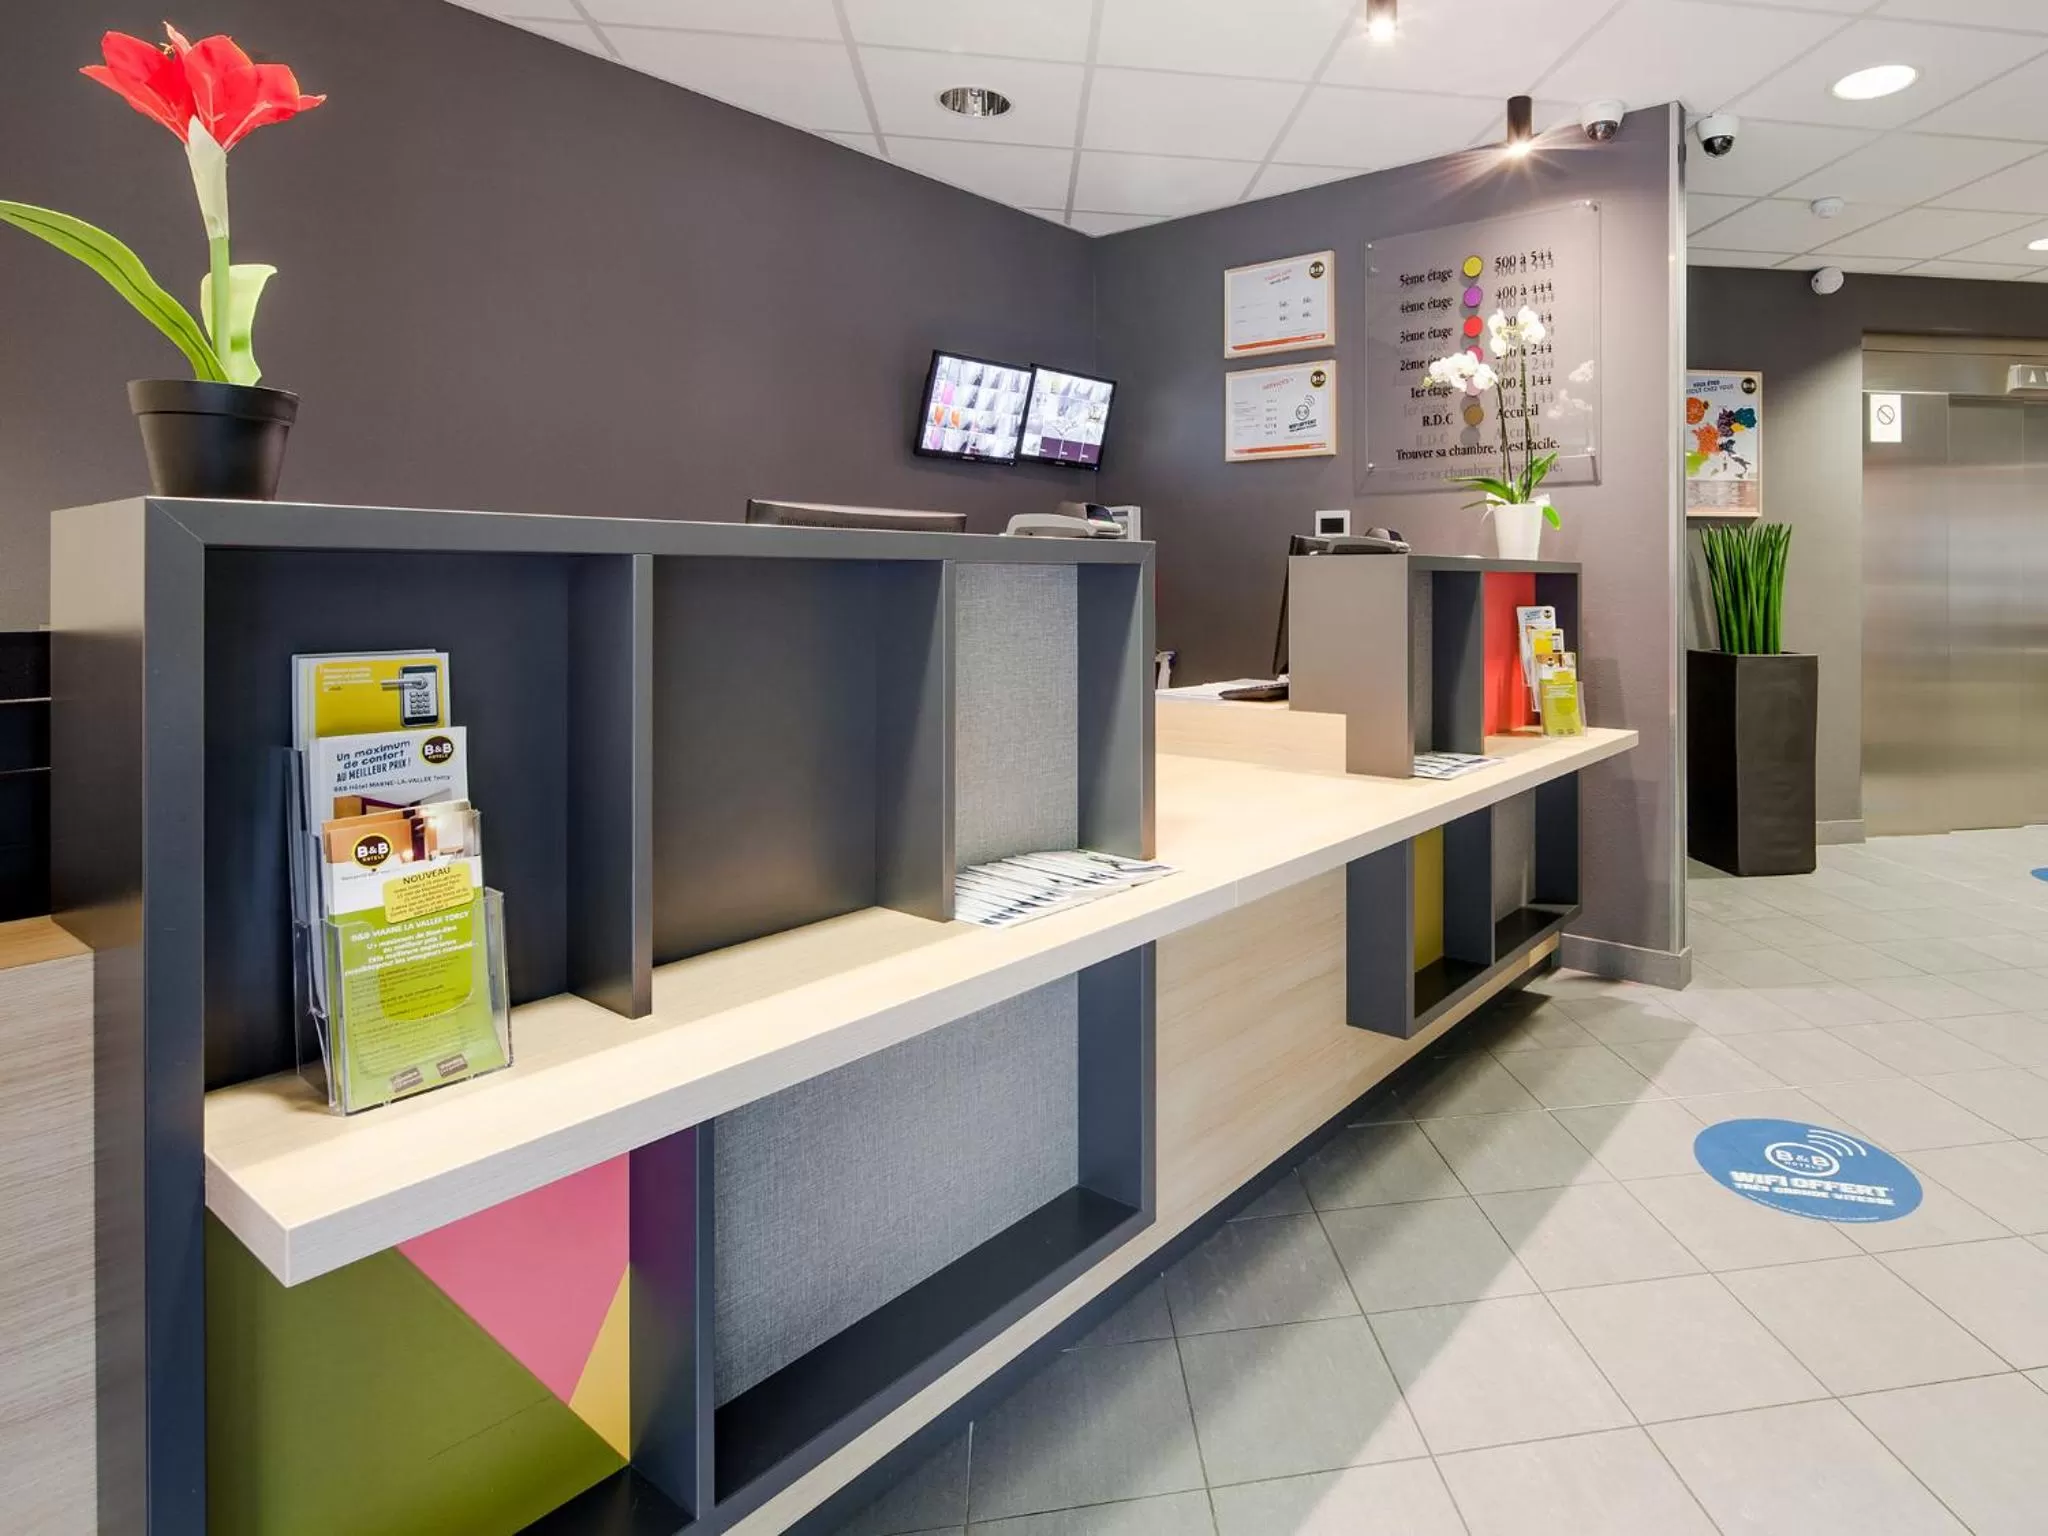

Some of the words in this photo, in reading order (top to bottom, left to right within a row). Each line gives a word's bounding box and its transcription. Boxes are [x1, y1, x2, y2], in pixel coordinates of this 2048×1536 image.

[1495, 255, 1517, 269] 500
[1520, 252, 1527, 264] à
[1530, 248, 1552, 265] 544
[1400, 271, 1425, 288] 5ème
[1427, 268, 1454, 283] étage
[1496, 285, 1517, 299] 400
[1520, 284, 1527, 295] à
[1530, 280, 1552, 294] 444
[1427, 296, 1454, 310] étage
[1400, 328, 1425, 344] 3ème
[1427, 326, 1454, 340] étage
[1531, 341, 1552, 355] 244
[1400, 357, 1425, 371] 2ème
[1531, 373, 1552, 386] 144
[1422, 412, 1454, 427] R.D.C
[1396, 447, 1433, 461] Trouver
[1435, 447, 1447, 458] sa
[1450, 441, 1497, 457] chambre,
[336, 752, 350, 762] Un
[354, 740, 411, 758] maximum
[424, 742, 453, 756] B&B
[343, 759, 358, 770] de
[361, 750, 404, 766] confort
[336, 772, 348, 782] AU
[348, 762, 387, 780] MEILLEUR
[388, 759, 407, 771] PRIX
[357, 842, 389, 858] B&B
[403, 866, 451, 885] NOUVEAU
[1775, 1149, 1831, 1167] B&B
[1729, 1170, 1788, 1187] WIFI
[1790, 1177, 1889, 1197] OFFERT
